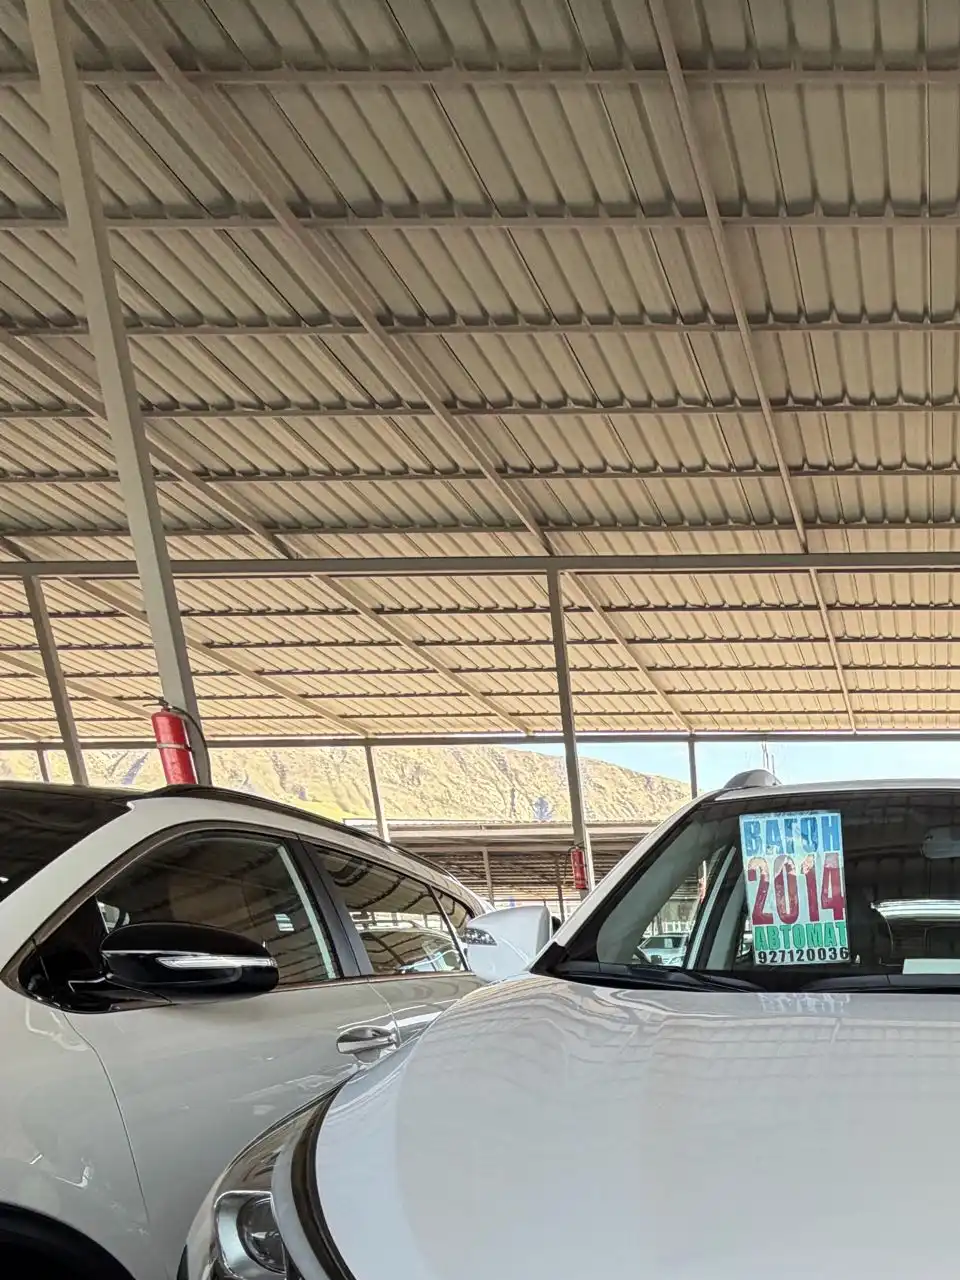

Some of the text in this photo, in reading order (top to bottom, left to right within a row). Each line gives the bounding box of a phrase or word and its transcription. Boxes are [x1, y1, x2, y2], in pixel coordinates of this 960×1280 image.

[747, 853, 844, 925] 2014
[754, 922, 848, 952] АВТОМАТ
[757, 946, 850, 964] 927120036
